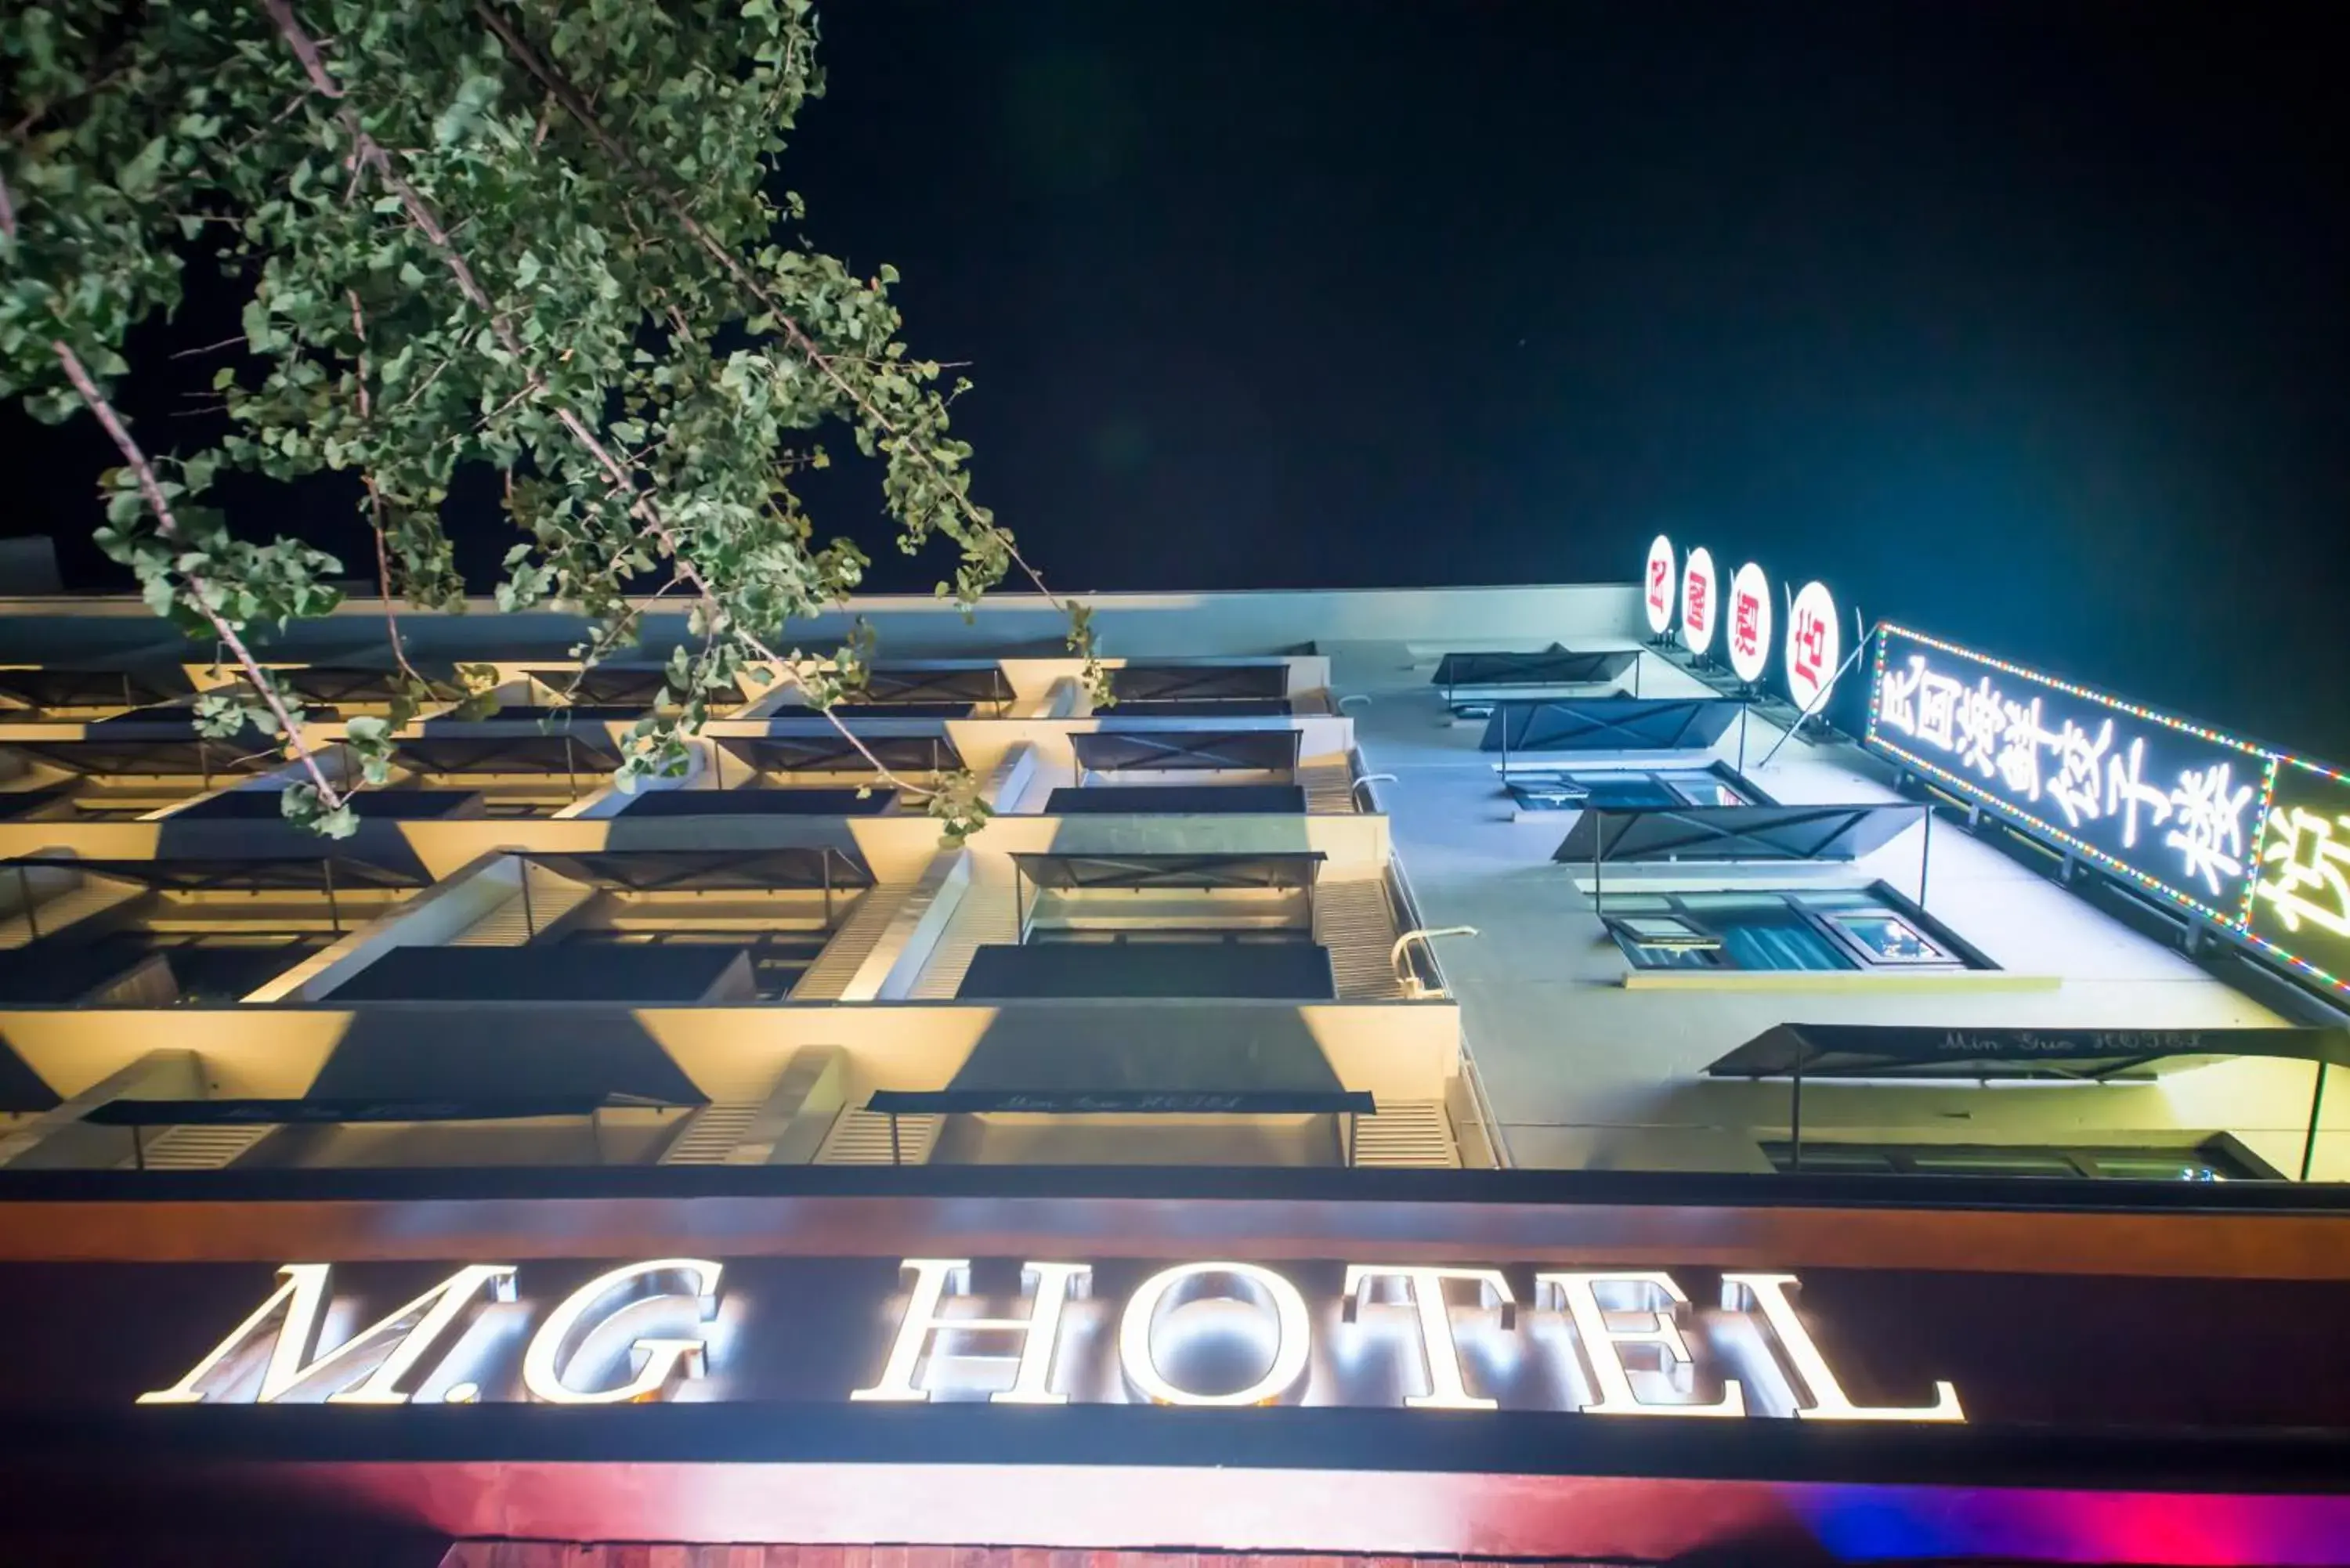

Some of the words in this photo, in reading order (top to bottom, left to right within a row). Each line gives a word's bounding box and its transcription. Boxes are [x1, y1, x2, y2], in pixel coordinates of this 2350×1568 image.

[1881, 655, 2253, 897] 民国海鲜饺子楼
[850, 1258, 1968, 1423] HOTEL
